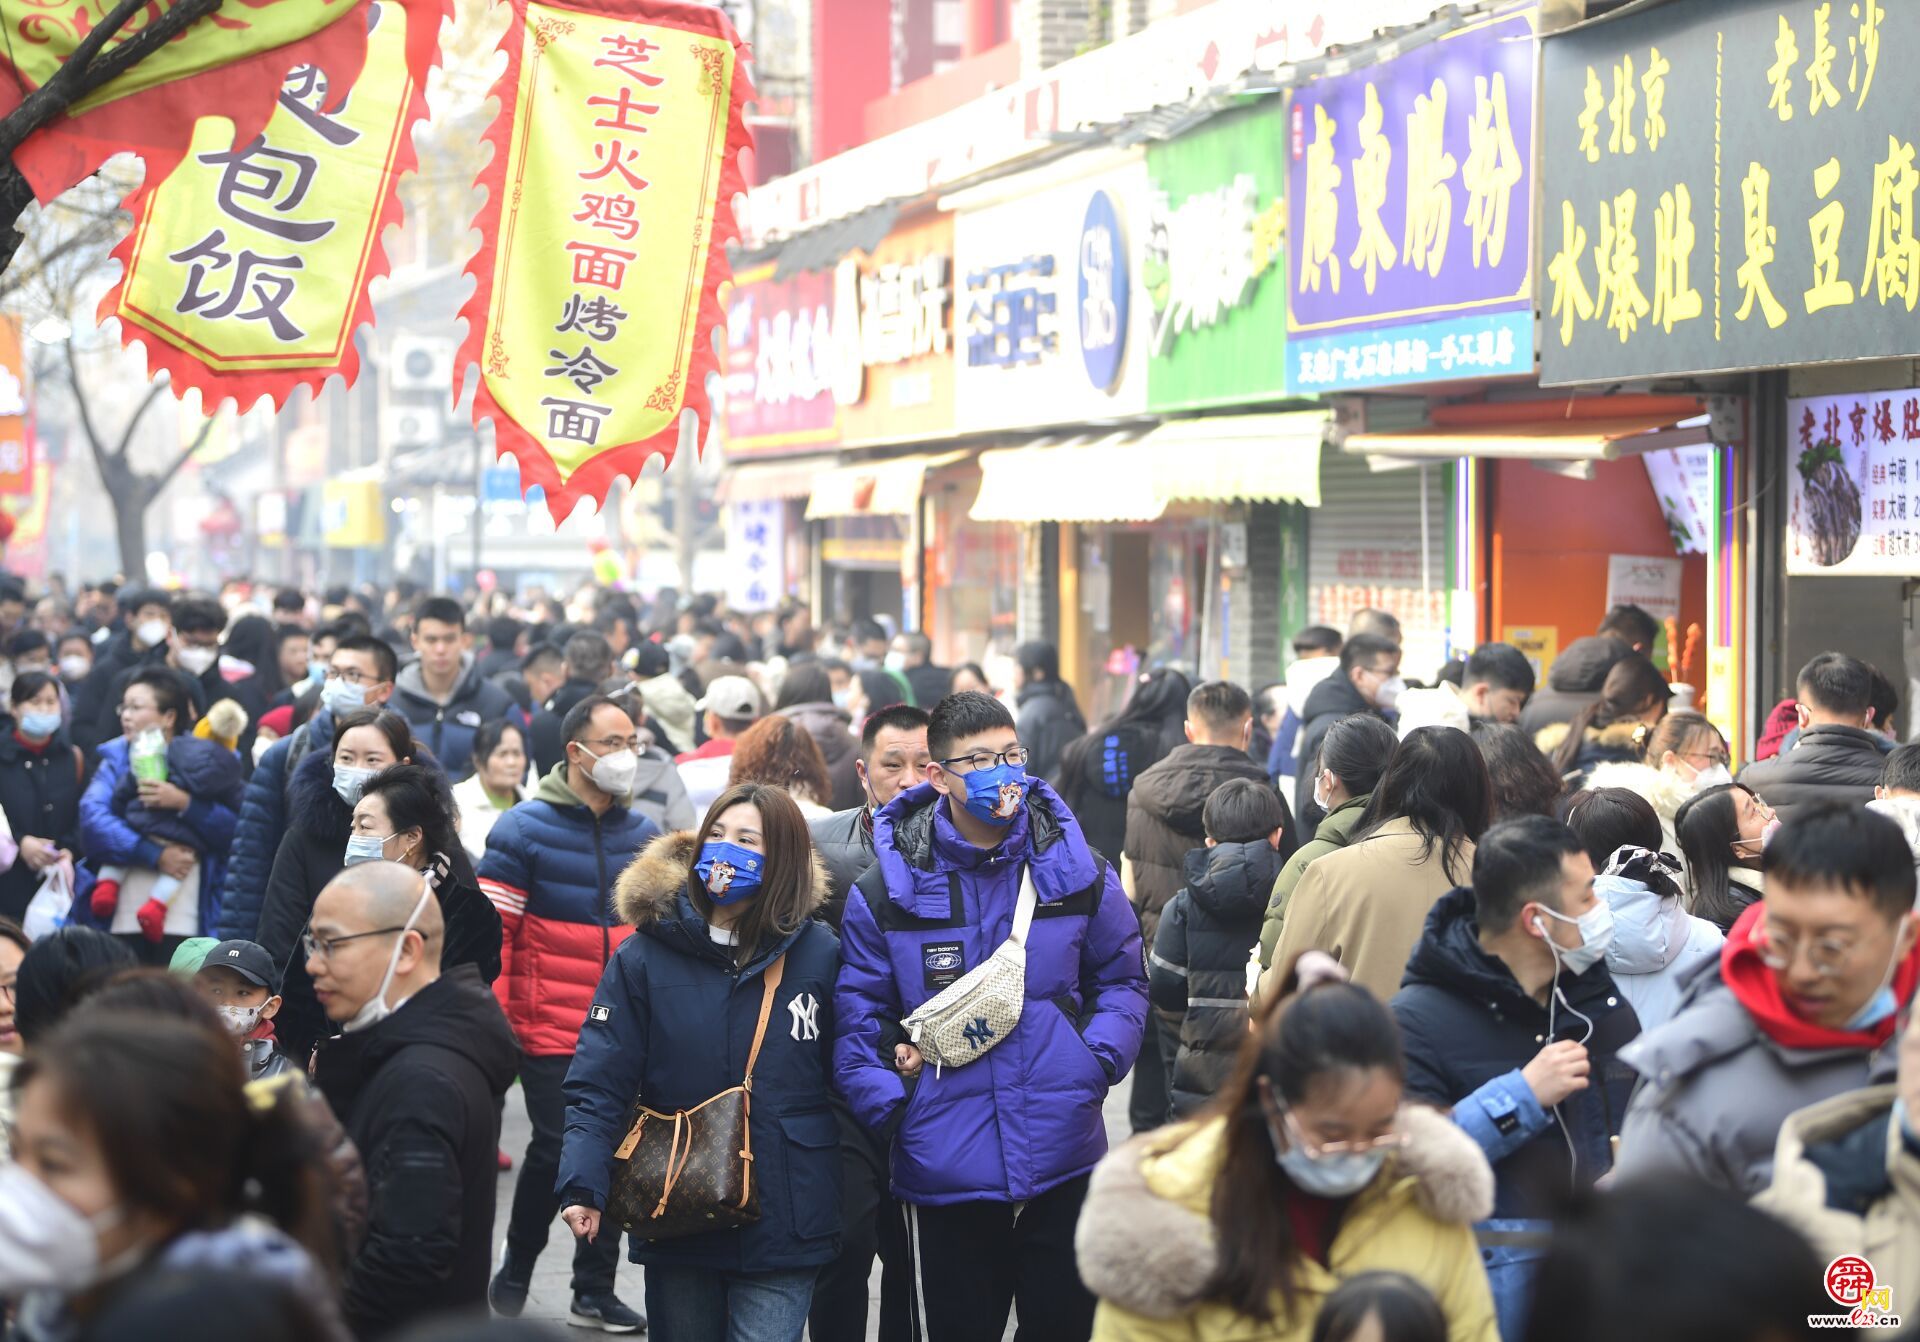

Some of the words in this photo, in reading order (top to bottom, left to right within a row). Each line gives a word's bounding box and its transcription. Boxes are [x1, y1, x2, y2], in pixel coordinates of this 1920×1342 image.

[1578, 47, 1670, 163] 老北京
[1547, 182, 1702, 347] 水爆肚
[1735, 134, 1920, 329] 臭豆腐
